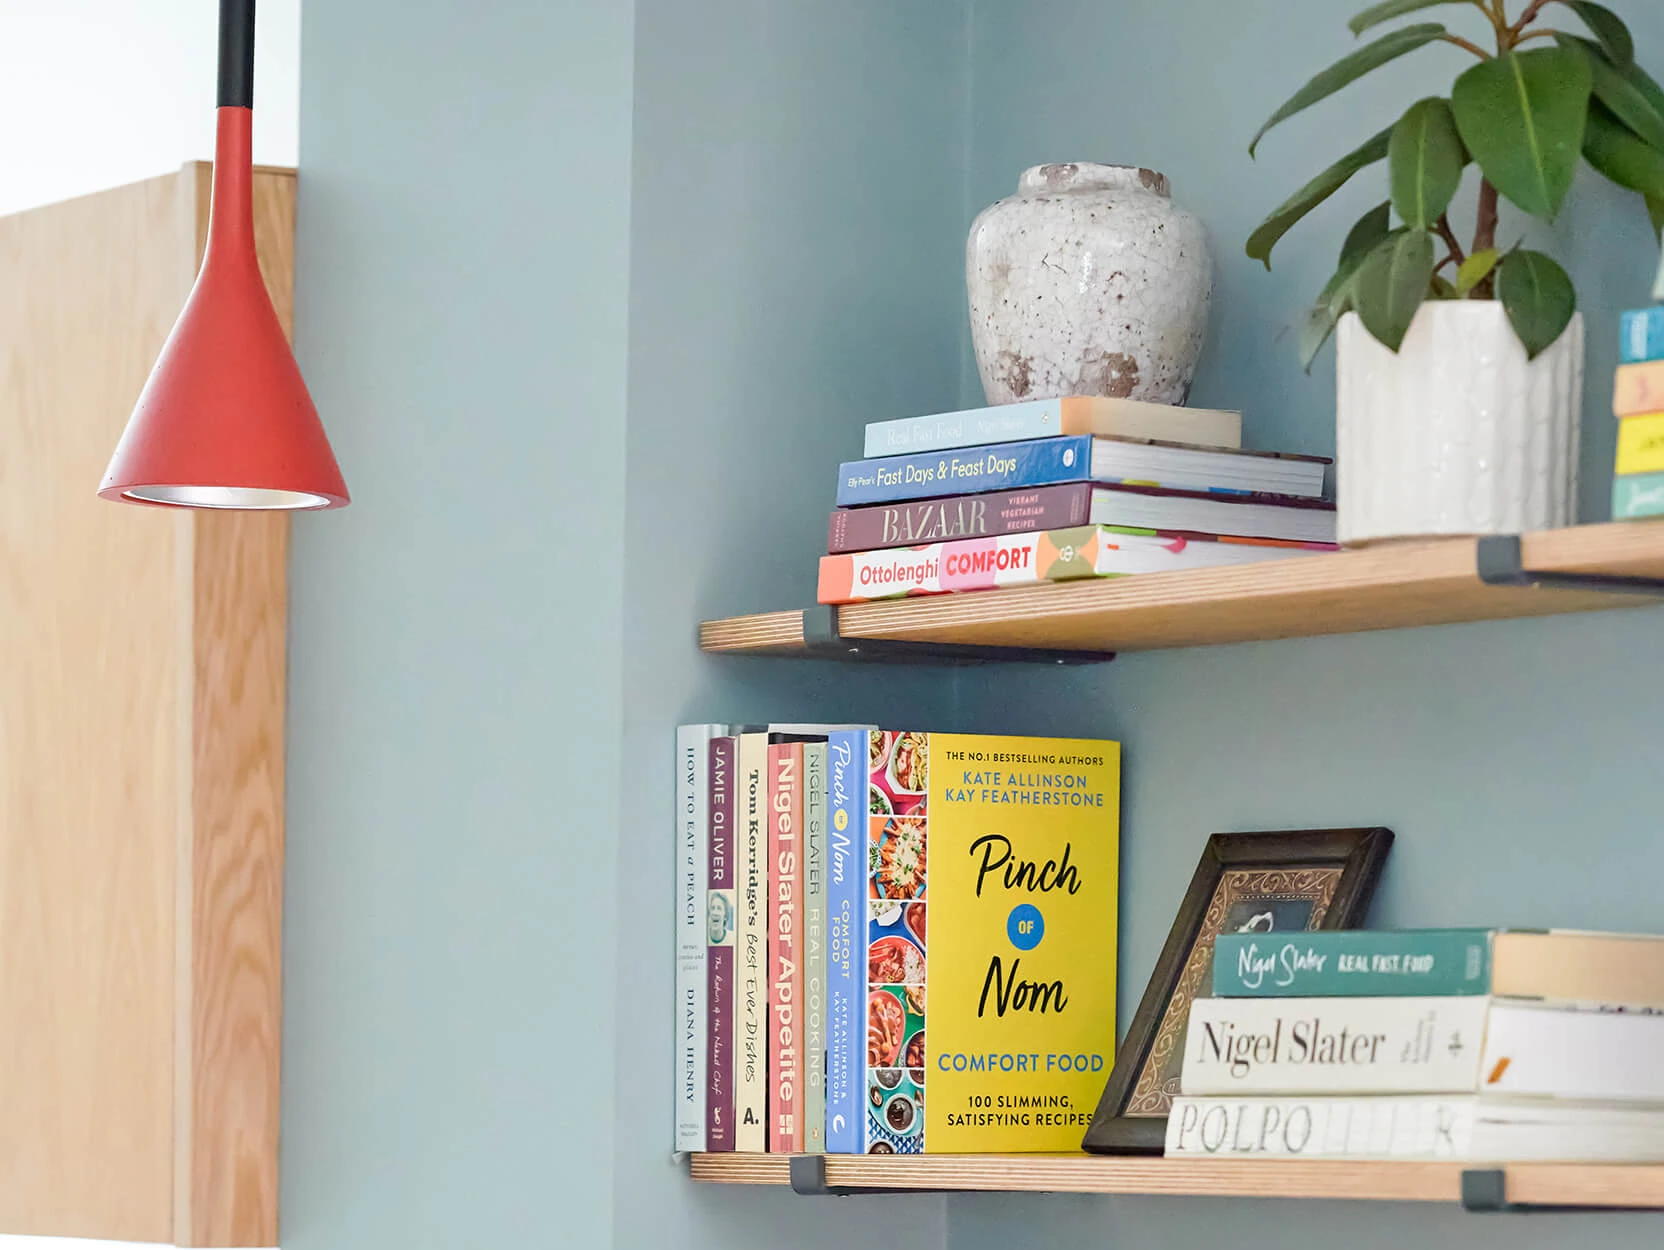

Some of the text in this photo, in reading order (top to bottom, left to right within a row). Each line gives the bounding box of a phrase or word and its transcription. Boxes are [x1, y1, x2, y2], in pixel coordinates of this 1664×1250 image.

[877, 467, 902, 487] Fast
[905, 465, 934, 487] Days
[936, 460, 948, 479] &
[951, 458, 984, 478] Feast
[987, 455, 1017, 478] Days
[1000, 506, 1045, 519] VEGETARIAN
[1008, 494, 1040, 507] VIBRANT
[880, 501, 987, 543] BAZAAR
[1007, 519, 1036, 530] RECIPES
[859, 546, 1032, 587] Ottolenghi COMFORT
[831, 740, 851, 807] Pinch
[946, 751, 1104, 766] THE NO.1 BESTSELLING AUTHORS
[945, 788, 1104, 807] KAY FEATHERSTONE
[963, 771, 1087, 789] KATE ALLINSON
[713, 746, 726, 881] JAMIE OLIVER
[687, 747, 695, 925] HOW TO EAT a PEACH
[831, 832, 851, 886] Nom
[969, 834, 1082, 898] Pinch
[745, 768, 759, 1083] Tom Kerridge's Best Ever Dishes
[773, 758, 796, 1102] Nigel Slater Appetite
[809, 754, 820, 1087] NIGEL SLATER REAL COOKING
[832, 916, 841, 962] FOOD
[841, 899, 850, 979] COMFORT
[1018, 920, 1034, 935] OF
[714, 956, 722, 970] The
[1238, 943, 1434, 989] Nigel Slater REAL FAST FOOD
[977, 955, 1068, 1018] Nom
[686, 989, 695, 1102] DIANA HENRY
[713, 1035, 724, 1066] Naked
[938, 1053, 1104, 1073] COMFORT FOOD
[1197, 1017, 1282, 1080] Nigel
[1288, 1017, 1386, 1065] Slater
[711, 1070, 722, 1096] Chef
[968, 1095, 1074, 1110] 100 SLIMMING,
[947, 1113, 1092, 1126] SATISFYING RECIPES
[1175, 1103, 1312, 1153] POLPO
